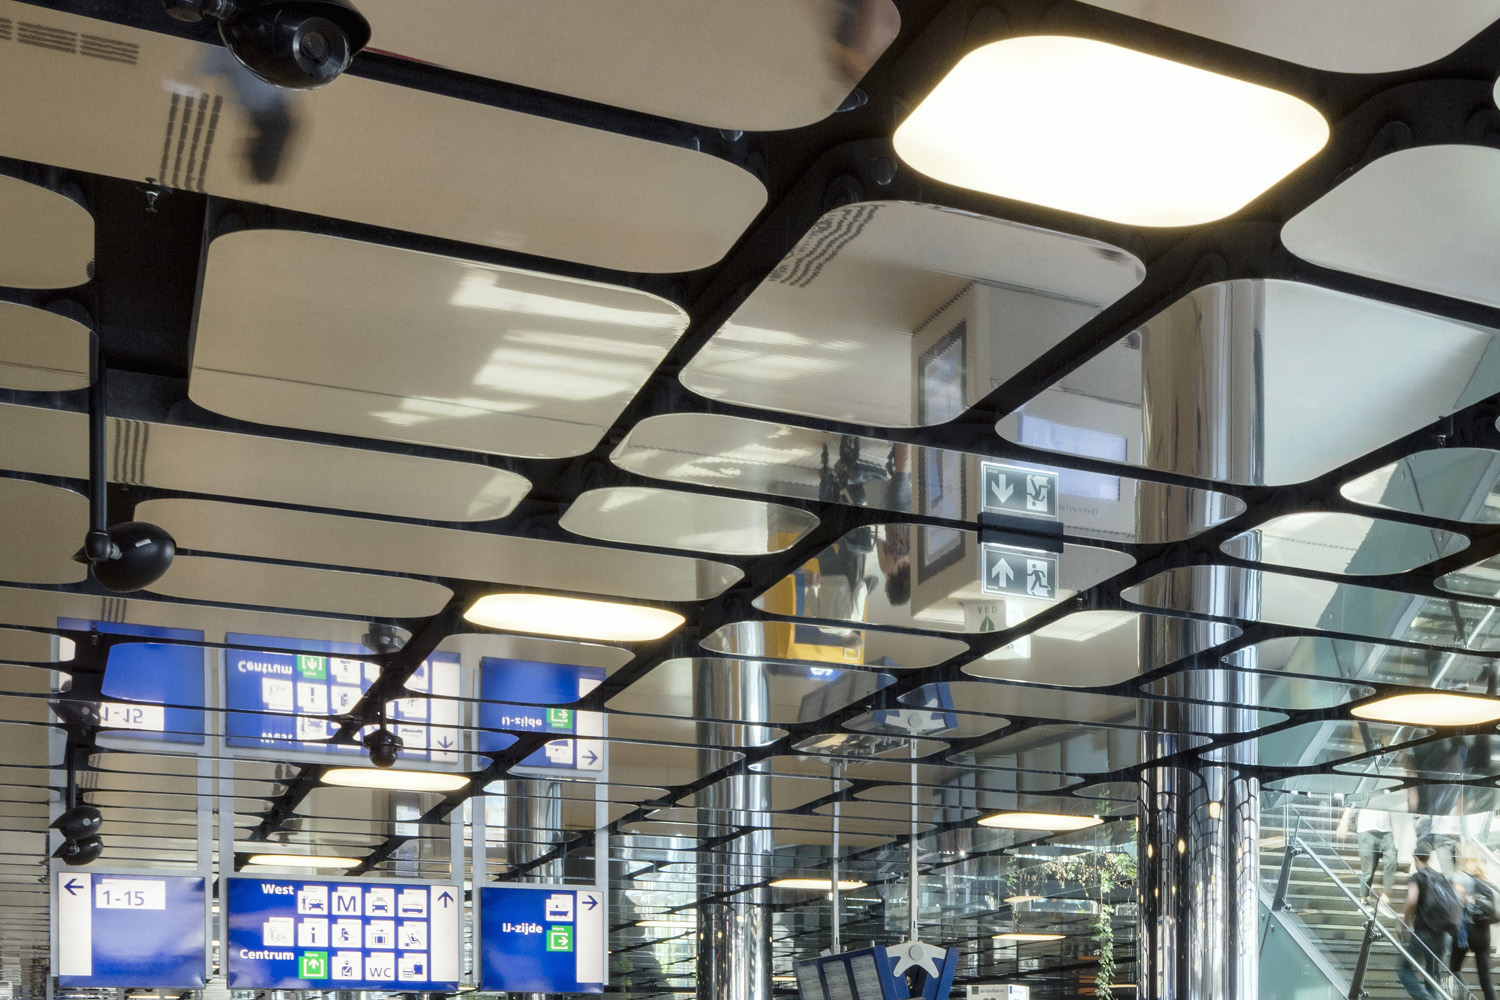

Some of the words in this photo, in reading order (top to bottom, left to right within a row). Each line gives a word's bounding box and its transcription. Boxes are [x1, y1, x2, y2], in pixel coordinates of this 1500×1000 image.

[261, 883, 295, 895] West
[102, 890, 145, 907] 1-15
[337, 895, 357, 912] M
[502, 922, 543, 935] IJ-zijde
[239, 949, 295, 961] Centrum
[369, 967, 392, 978] WC
